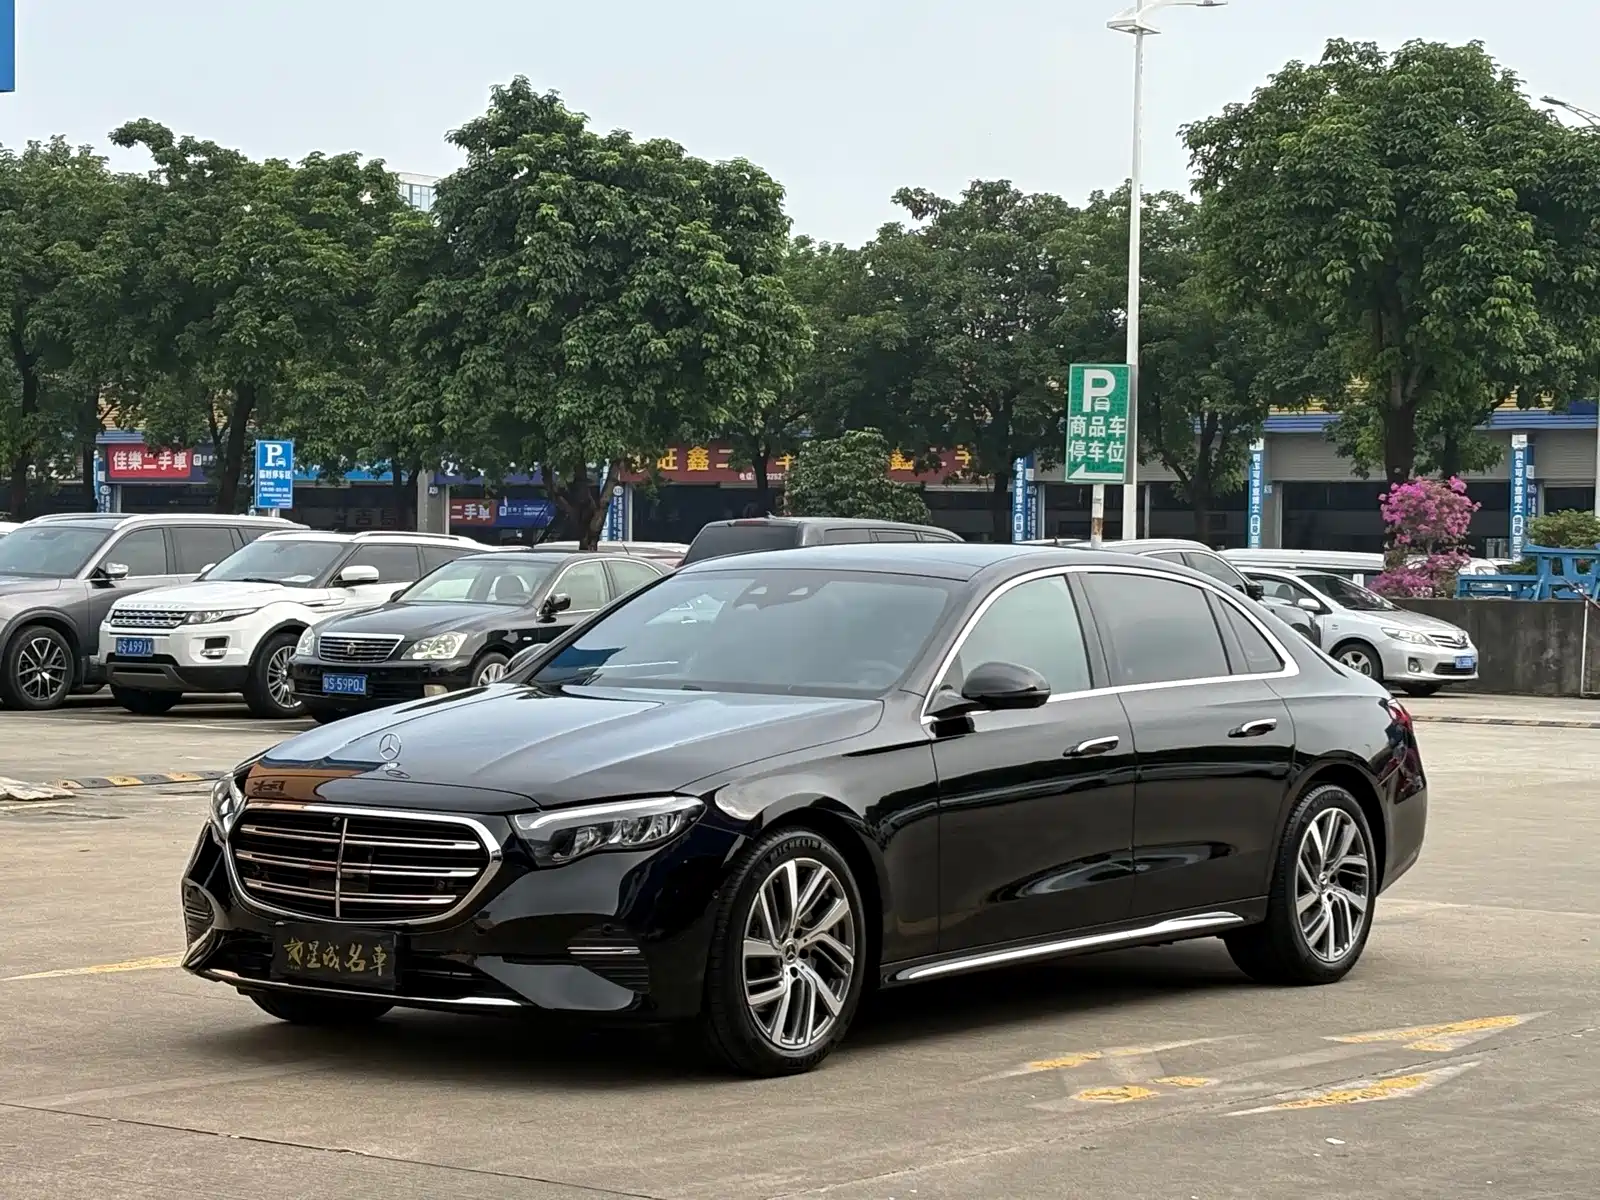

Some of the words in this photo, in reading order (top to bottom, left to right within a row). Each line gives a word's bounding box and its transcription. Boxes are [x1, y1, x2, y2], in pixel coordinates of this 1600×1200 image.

[1082, 368, 1116, 413] P
[1069, 415, 1126, 438] 商品车
[113, 450, 188, 471] 佳樂二手車
[264, 443, 283, 467] P
[1068, 440, 1124, 463] 停车位
